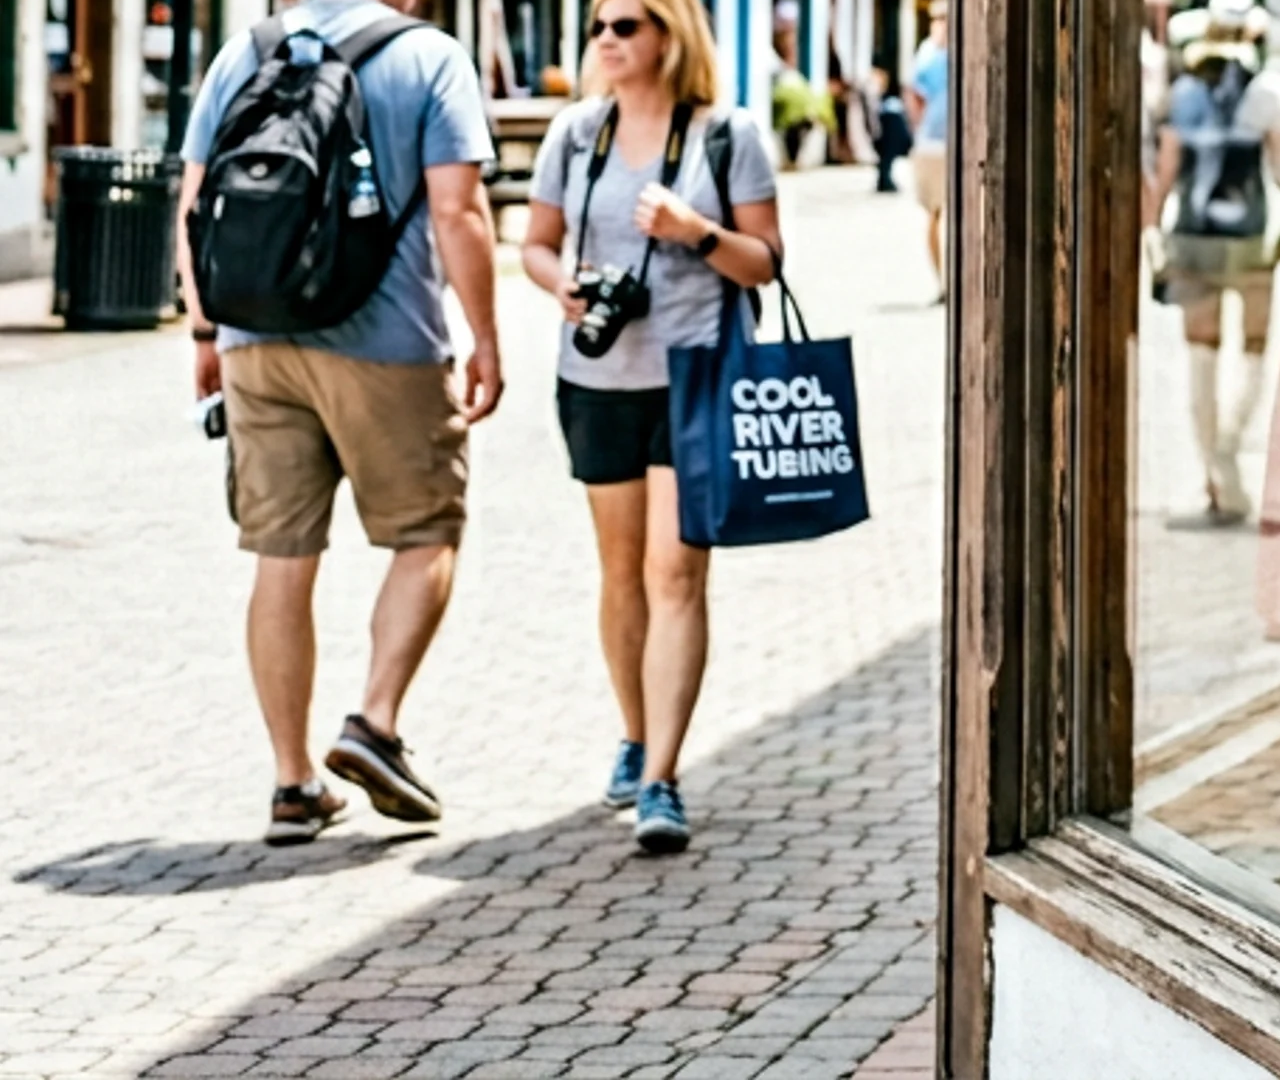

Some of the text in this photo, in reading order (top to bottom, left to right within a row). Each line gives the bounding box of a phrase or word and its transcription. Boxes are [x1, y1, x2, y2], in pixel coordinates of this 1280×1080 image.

[731, 375, 835, 411] COOL
[732, 410, 846, 447] RIVER
[730, 444, 854, 479] TUBING
